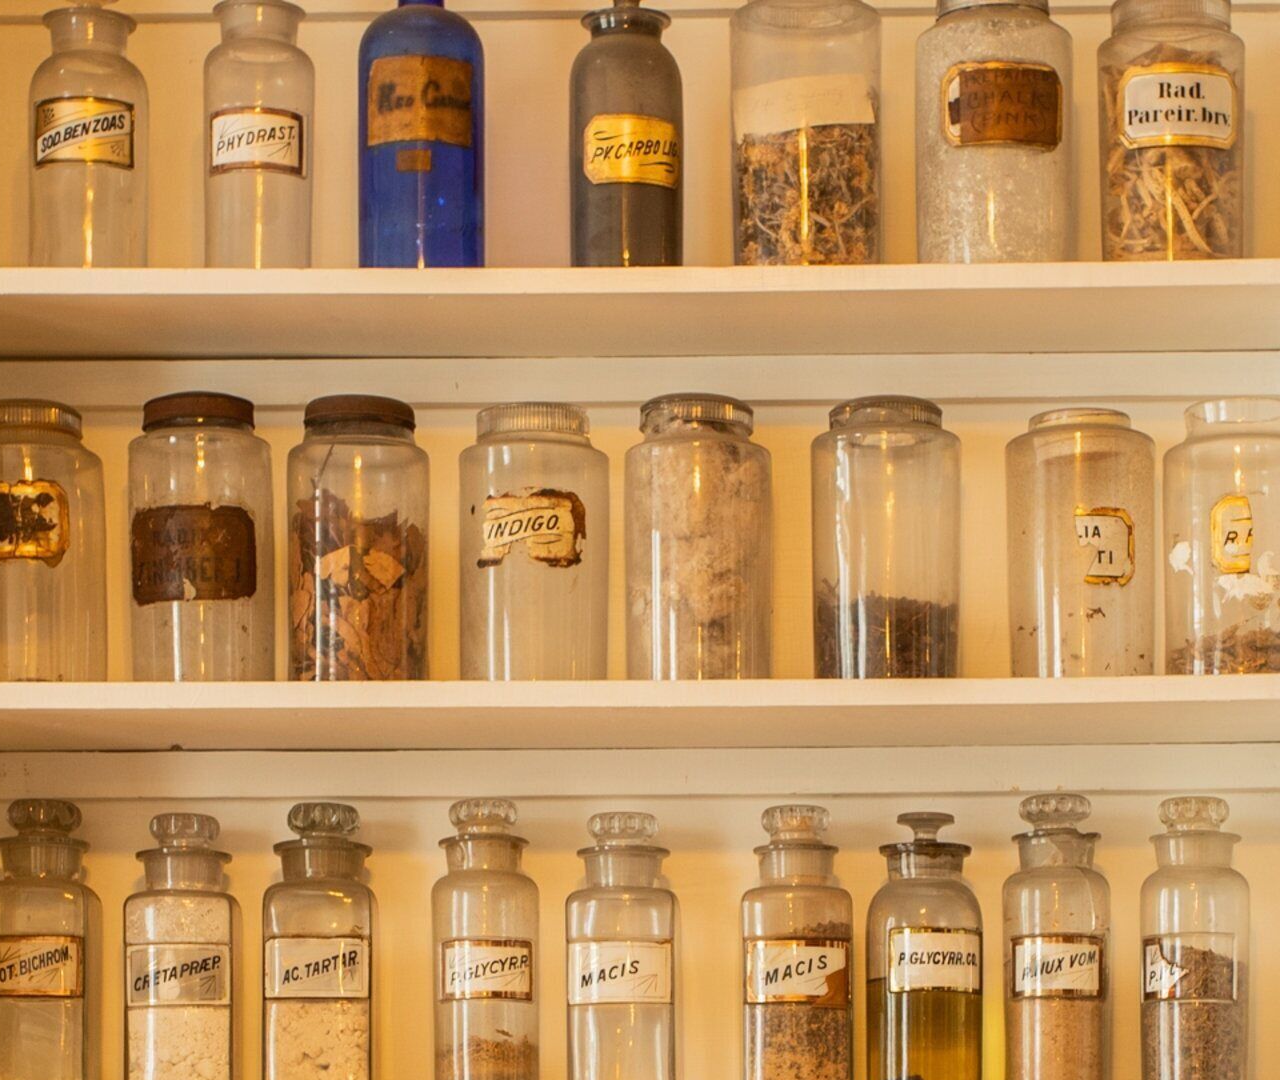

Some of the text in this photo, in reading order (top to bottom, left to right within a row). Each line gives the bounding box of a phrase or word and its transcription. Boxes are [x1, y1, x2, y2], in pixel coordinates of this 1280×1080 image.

[1158, 82, 1205, 99] Rad.
[488, 514, 560, 541] INDIGO.
[581, 960, 639, 988] MACIS
[764, 955, 827, 986] MACIS
